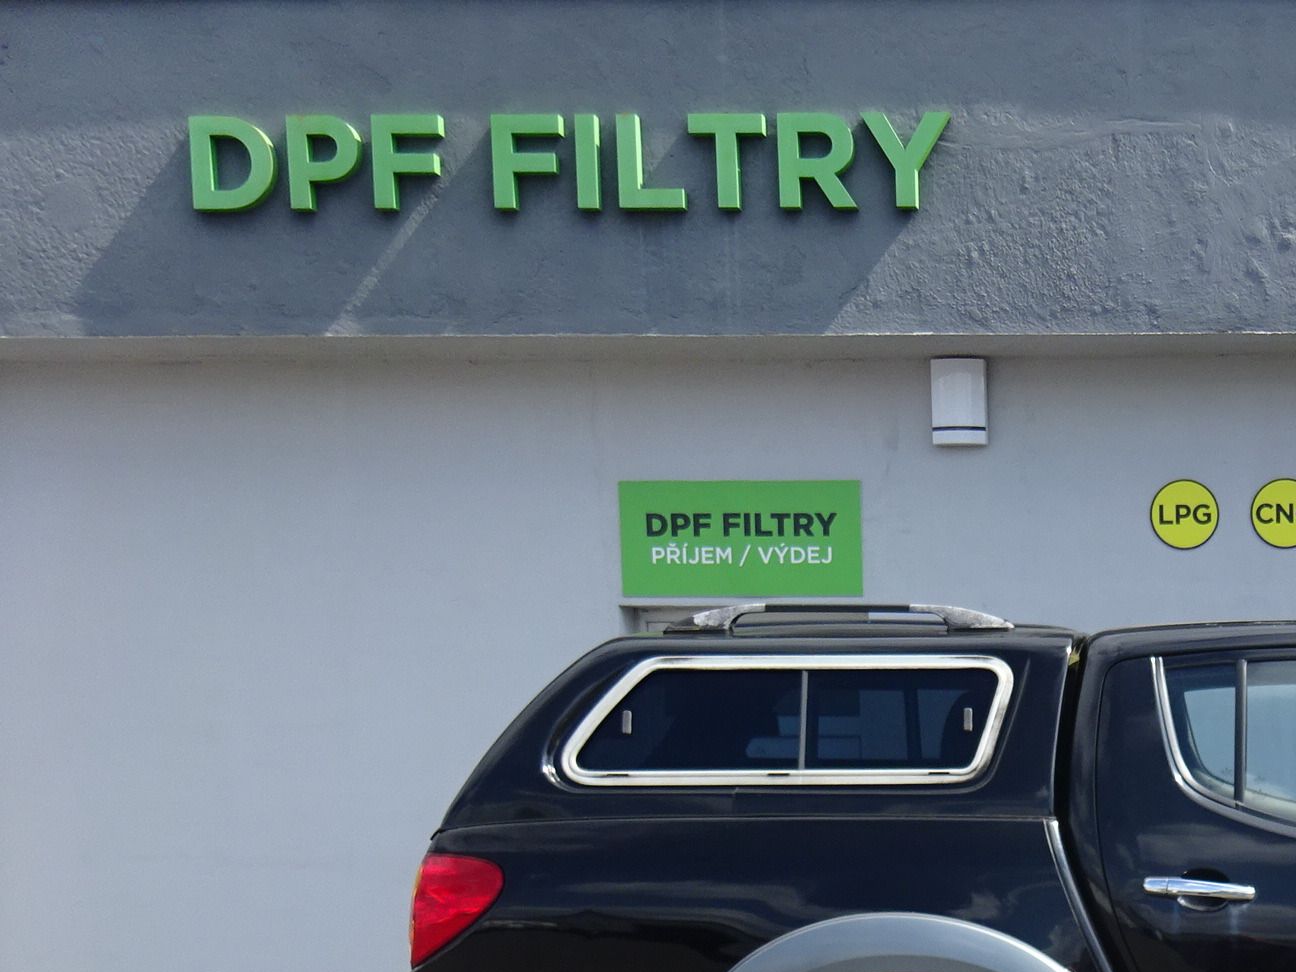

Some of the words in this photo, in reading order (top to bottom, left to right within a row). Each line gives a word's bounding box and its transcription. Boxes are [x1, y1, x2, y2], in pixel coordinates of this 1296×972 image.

[188, 114, 445, 212] DPF
[490, 110, 951, 212] FILTRY
[645, 512, 712, 537] DPF
[722, 512, 838, 537] FILTRY
[1158, 503, 1212, 525] LPG
[651, 543, 733, 565] PŘÍJEM
[757, 543, 833, 565] VÝDEJ
